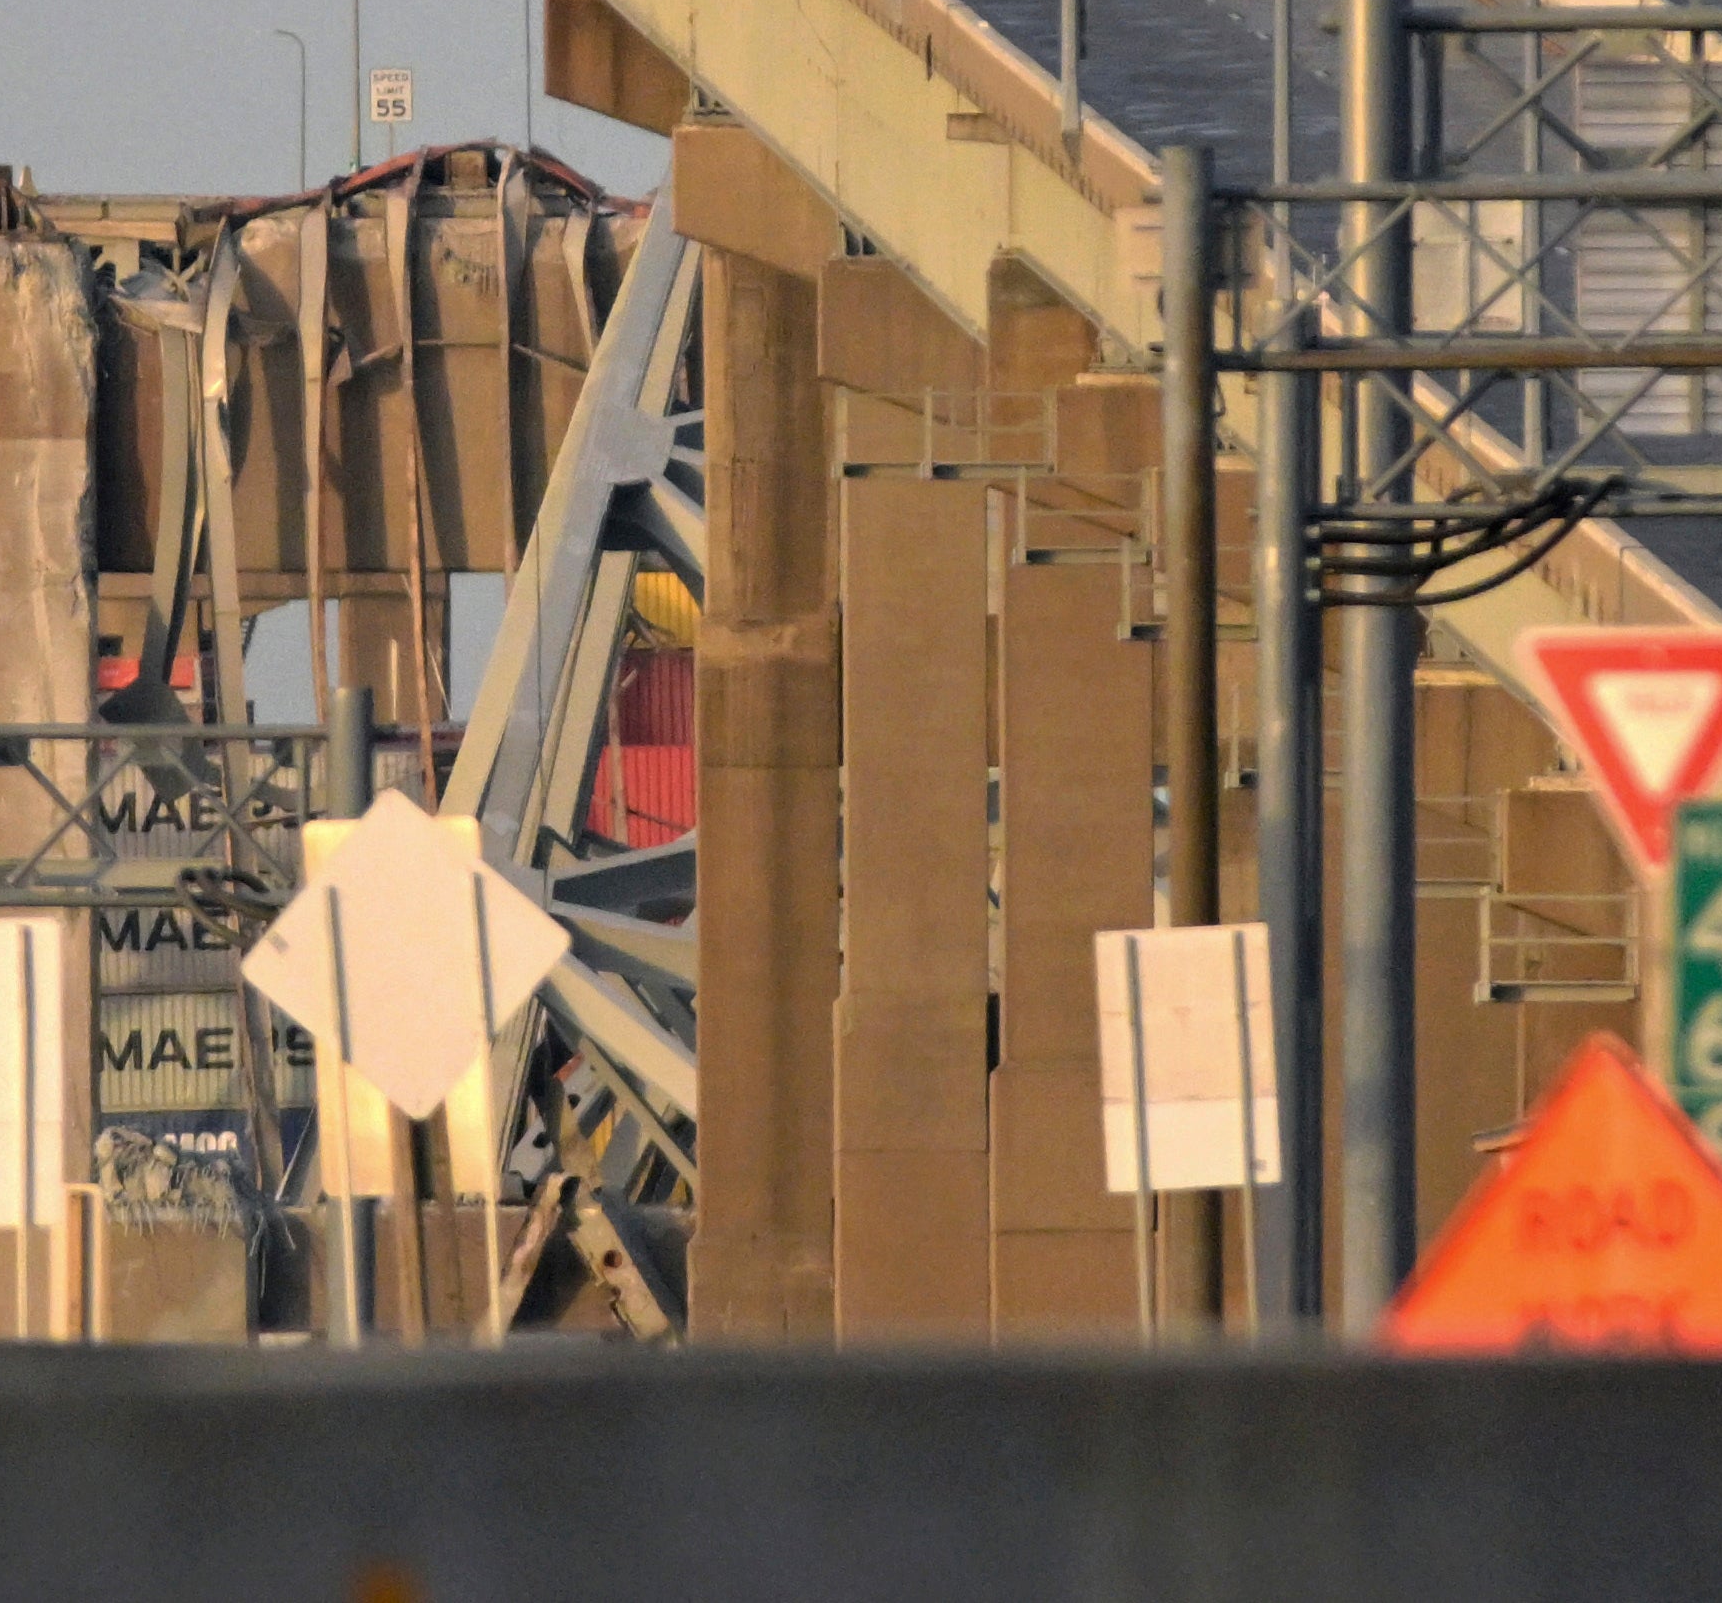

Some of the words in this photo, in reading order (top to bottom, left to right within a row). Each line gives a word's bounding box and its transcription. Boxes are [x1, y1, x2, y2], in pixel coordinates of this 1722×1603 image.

[373, 73, 409, 82] SPEED
[376, 86, 406, 95] LIMIT
[377, 99, 407, 117] 55
[1518, 1174, 1695, 1255] ROAD
